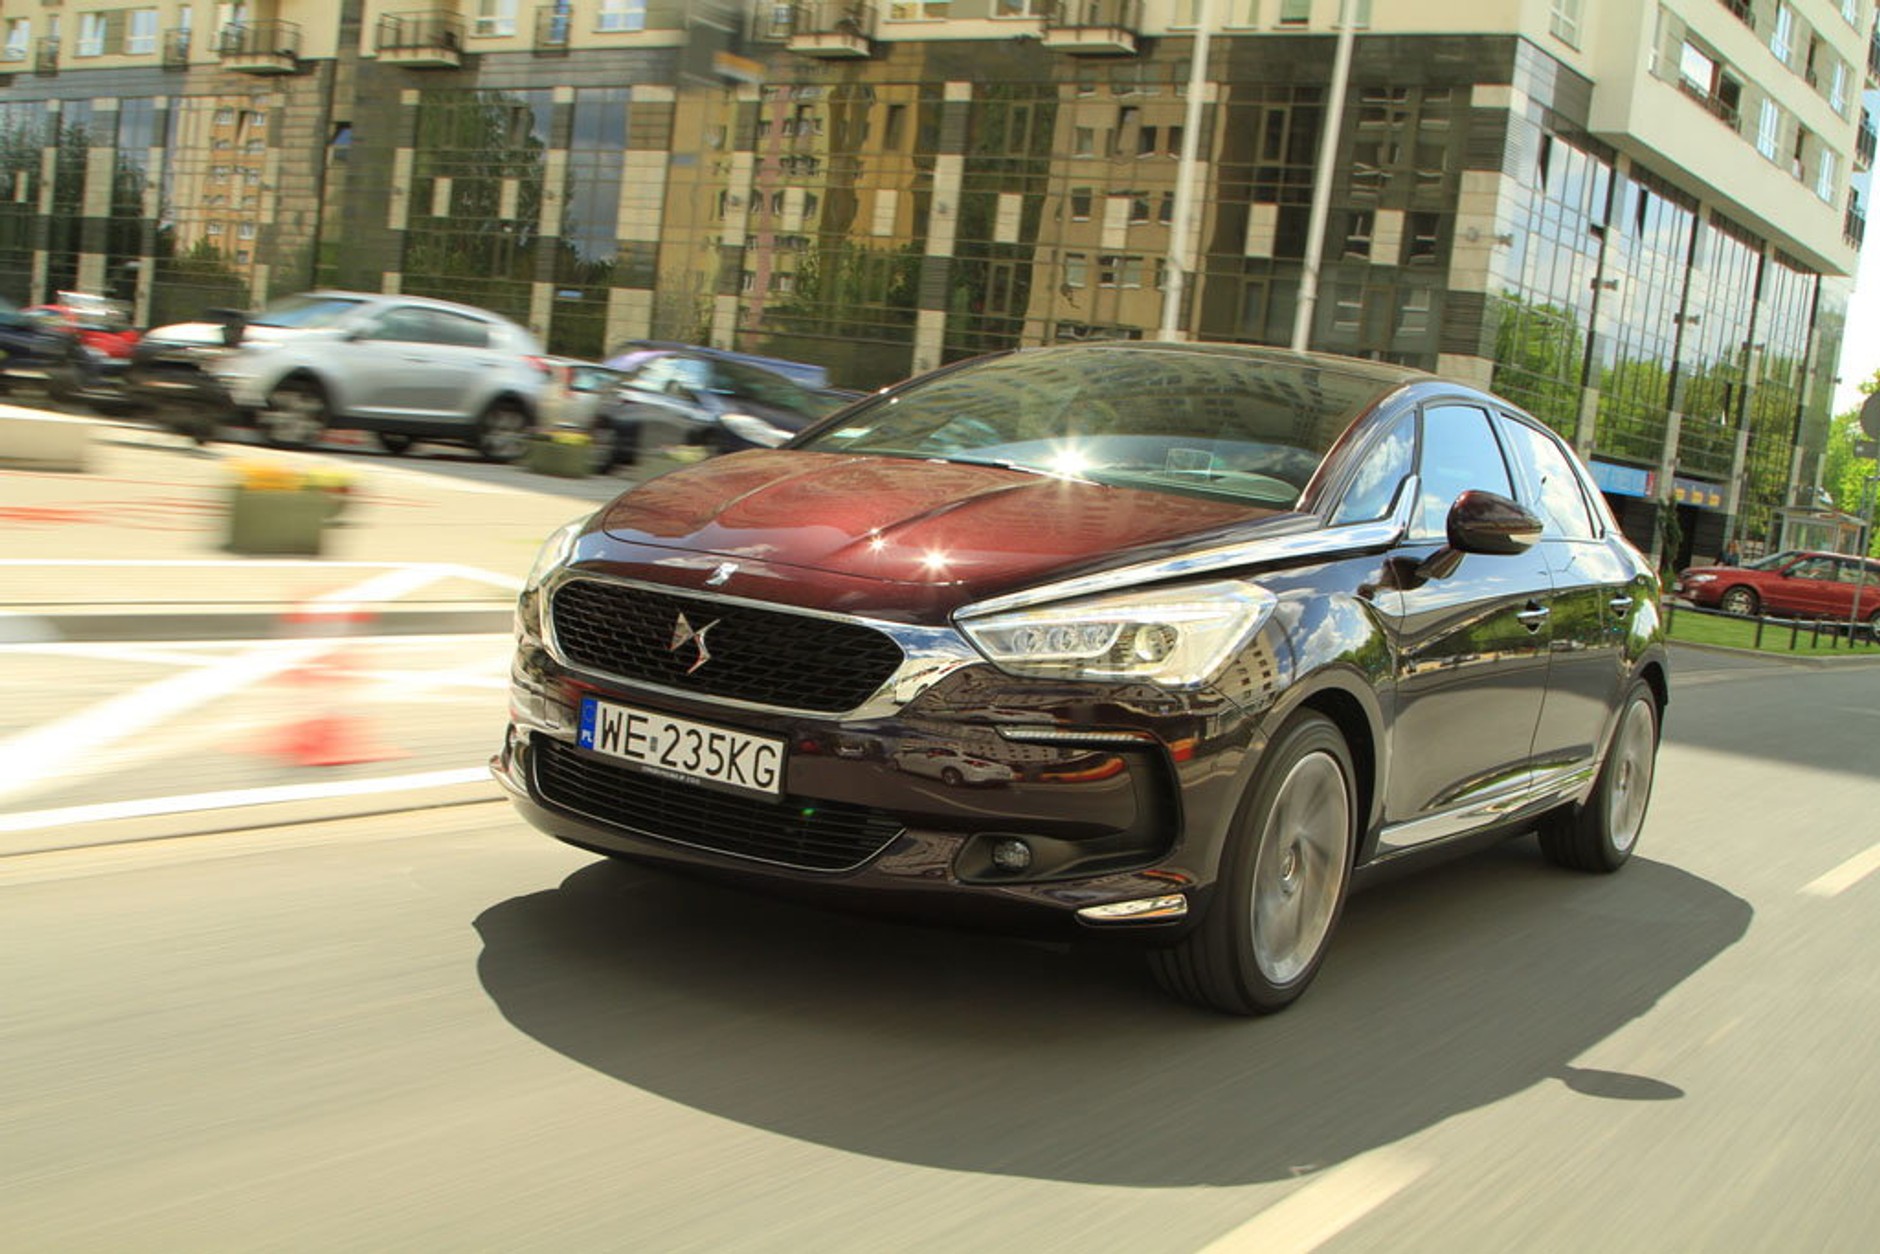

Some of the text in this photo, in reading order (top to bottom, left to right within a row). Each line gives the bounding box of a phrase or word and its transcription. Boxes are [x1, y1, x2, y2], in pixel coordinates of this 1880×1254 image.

[581, 729, 593, 743] PL
[601, 707, 776, 788] WE 235KG
